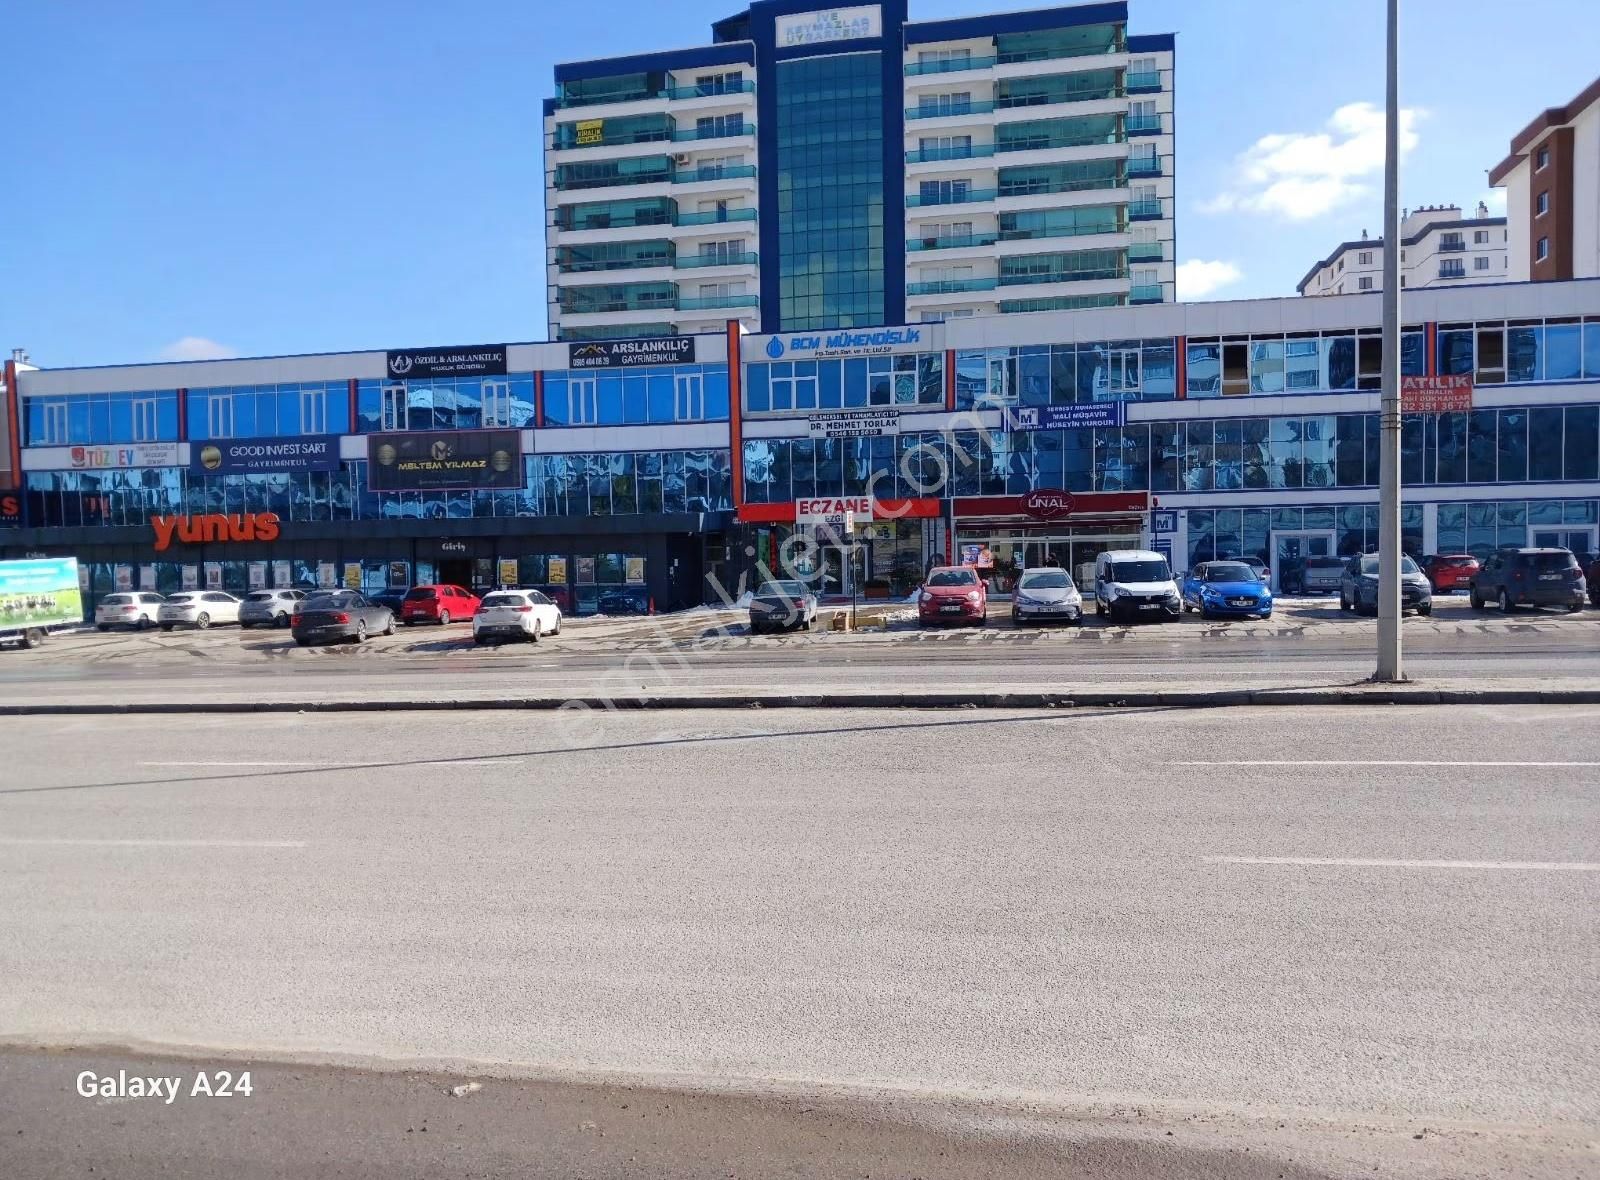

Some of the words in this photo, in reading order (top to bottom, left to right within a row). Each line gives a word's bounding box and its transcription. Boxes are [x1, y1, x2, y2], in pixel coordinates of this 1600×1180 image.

[790, 335, 820, 350] BCM
[825, 328, 920, 349] MÜHENDİSLİK
[611, 340, 689, 354] ARSLANKILIÇ
[1402, 376, 1469, 389] ATILIK
[1053, 412, 1071, 420] MALİ
[1072, 411, 1108, 419] MÜŞAVİR
[810, 423, 824, 431] DR.
[826, 421, 861, 430] MEHMET
[864, 420, 897, 428] TORLAK
[229, 446, 265, 457] GOOD
[266, 444, 301, 456] INVEST
[301, 443, 327, 454] SART
[398, 462, 443, 470] MELTEM
[444, 460, 487, 469] YILMAZ
[799, 499, 870, 515] ECZANE
[150, 512, 281, 551] yunus
